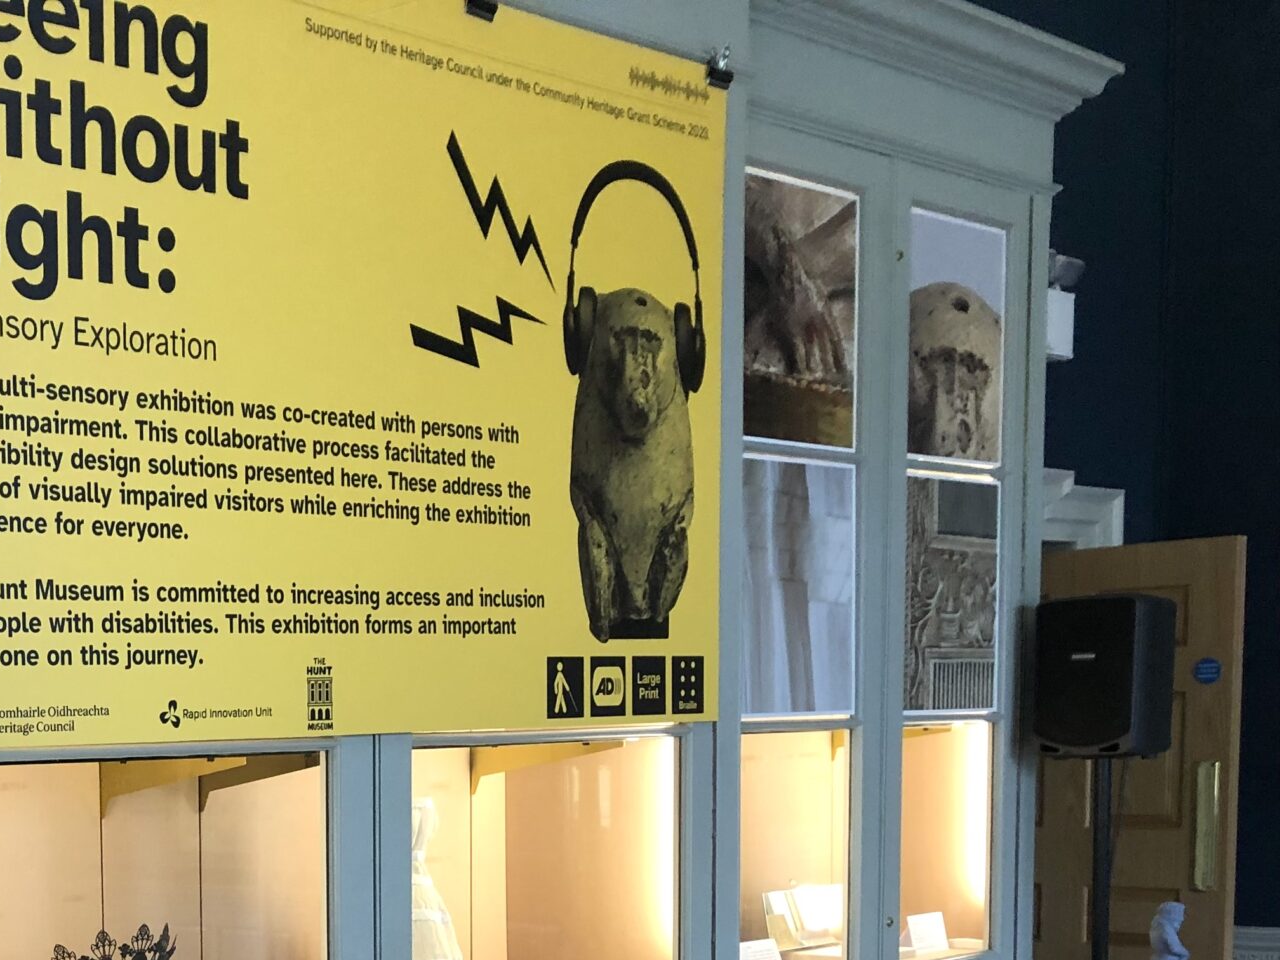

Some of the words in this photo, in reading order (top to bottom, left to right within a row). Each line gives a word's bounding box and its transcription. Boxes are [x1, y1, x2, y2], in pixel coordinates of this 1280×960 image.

[305, 17, 363, 46] Supported
[365, 32, 378, 54] by
[380, 38, 398, 56] the
[400, 44, 444, 71] Heritage
[447, 57, 484, 80] Council
[486, 67, 514, 89] under
[516, 76, 531, 93] the
[533, 82, 585, 110] Community
[587, 97, 625, 120] Heritage
[627, 107, 651, 125] Grant
[653, 114, 686, 134] Scheme
[74, 316, 217, 362] Exploration
[136, 389, 234, 416] exhibition
[242, 402, 277, 420] was
[283, 406, 375, 430] co-created
[381, 412, 415, 434] with
[421, 419, 483, 440] persons
[488, 422, 519, 444] with
[135, 419, 178, 443] This
[185, 427, 306, 454] collaborative
[313, 438, 379, 460] process
[385, 441, 466, 466] facilitated
[471, 450, 495, 469] the
[71, 448, 140, 477] design
[148, 455, 238, 479] solutions
[245, 463, 334, 486] presented
[341, 467, 382, 489] here.
[388, 471, 437, 492] These
[442, 476, 502, 498] address
[508, 481, 531, 500] the
[0, 476, 21, 499] of
[29, 476, 112, 508] visually
[119, 482, 208, 510] impaired
[214, 488, 284, 513] visitors
[291, 495, 337, 516] while
[343, 497, 420, 525] enriching
[425, 503, 450, 522] the
[455, 504, 531, 527] exhibition
[55, 511, 84, 535] for
[92, 518, 189, 542] everyone.
[35, 579, 124, 601] Museum
[132, 579, 149, 602] is
[156, 581, 259, 604] committed
[266, 585, 284, 604] to
[291, 582, 380, 609] increasing
[386, 589, 440, 607] access
[446, 588, 474, 607] and
[479, 587, 545, 608] inclusion
[49, 610, 94, 634] with
[101, 611, 218, 634] disabilities.
[225, 612, 265, 634] This
[272, 612, 359, 635] exhibition
[365, 614, 412, 634] forms
[418, 618, 437, 634] an
[442, 614, 516, 638] important
[47, 646, 72, 666] on
[80, 642, 119, 666] this
[125, 642, 204, 669] journey.
[313, 657, 326, 665] THE
[307, 666, 332, 676] HUNT
[637, 672, 661, 685] Large
[595, 677, 615, 696] AD
[639, 687, 659, 700] Print
[48, 704, 110, 718] Oidhreachta
[183, 707, 208, 721] Rapid
[209, 707, 253, 719] Innovation
[254, 706, 272, 718] Unit
[679, 700, 698, 710] Braille
[36, 720, 75, 733] Council
[307, 722, 334, 731] MUSEUM
